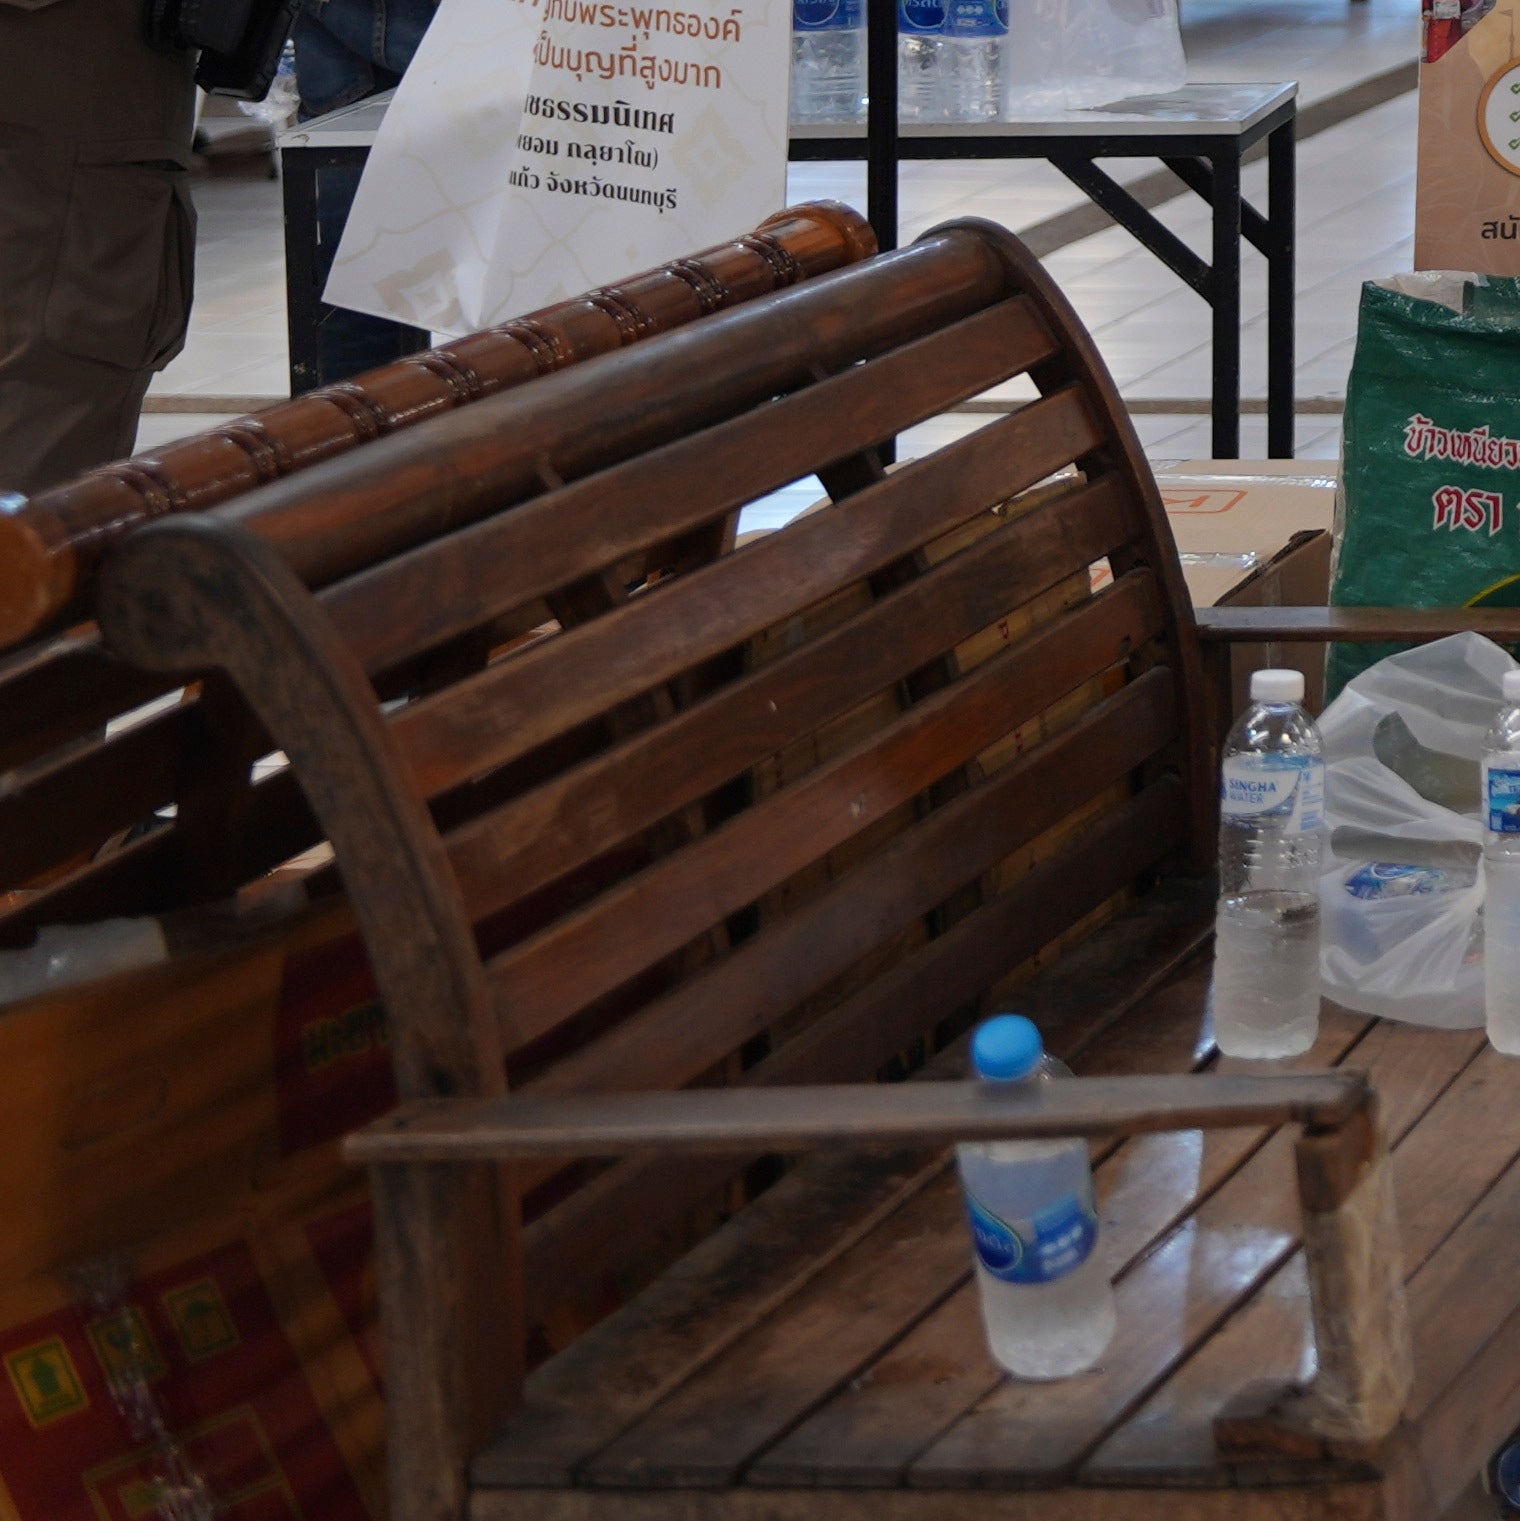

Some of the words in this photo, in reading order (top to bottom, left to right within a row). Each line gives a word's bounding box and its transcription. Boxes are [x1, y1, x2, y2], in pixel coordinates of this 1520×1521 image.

[546, 170, 678, 214] จังหวัดนนทบุรี
[1432, 484, 1503, 533] ตรา
[1228, 778, 1277, 793] SINGHA
